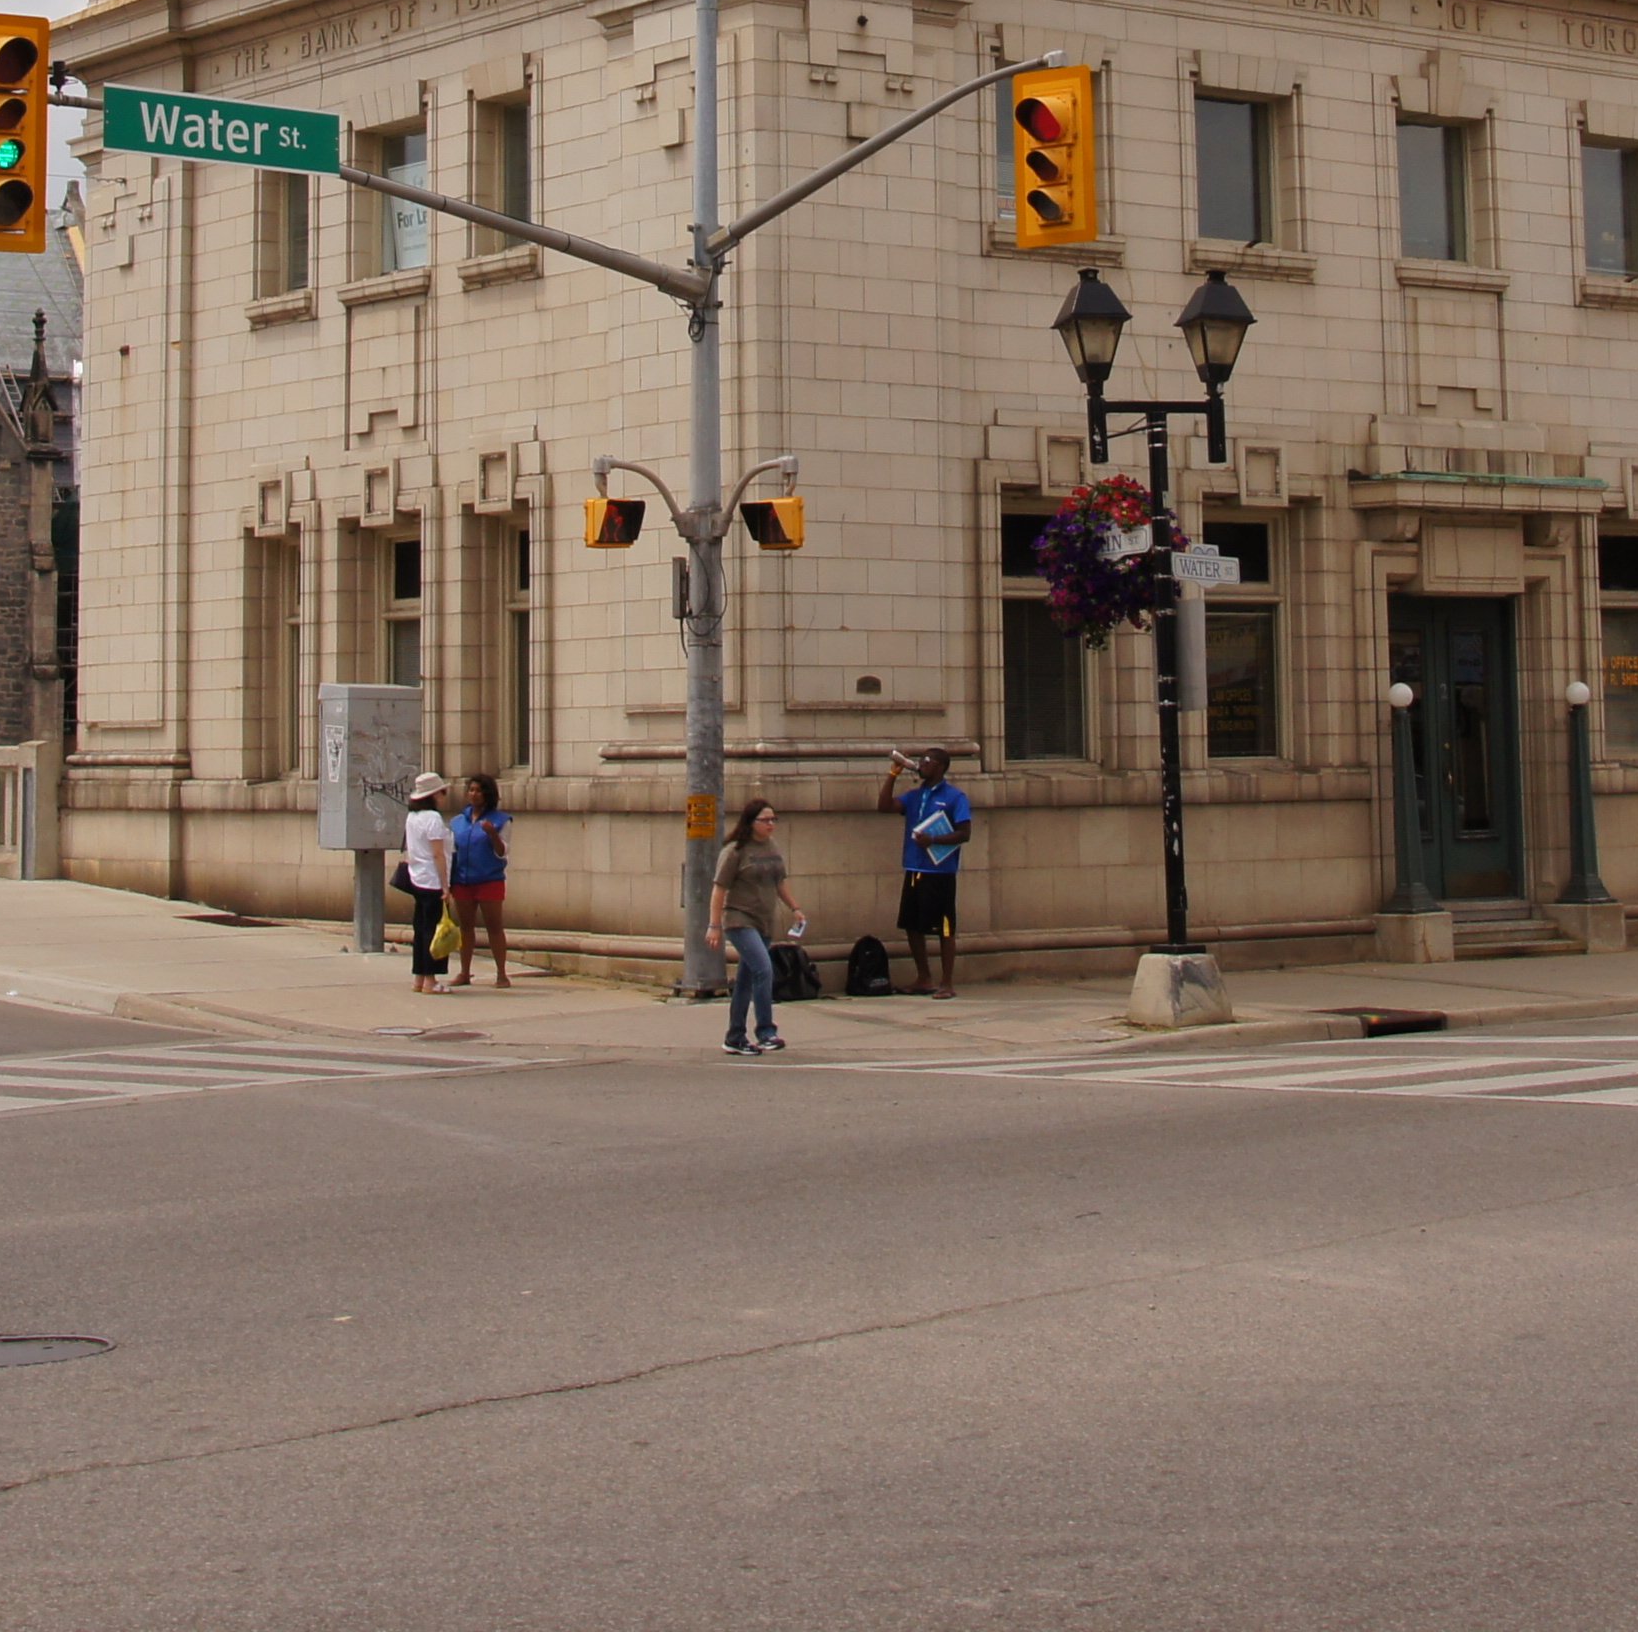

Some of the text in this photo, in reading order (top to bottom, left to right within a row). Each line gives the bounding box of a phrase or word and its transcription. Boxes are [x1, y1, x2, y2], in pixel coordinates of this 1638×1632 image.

[1451, 0, 1488, 32] OF
[231, 43, 270, 78] THE
[299, 16, 361, 60] BANK
[388, 0, 418, 34] OF
[139, 101, 307, 156] Water St.
[396, 211, 414, 229] For
[1179, 557, 1221, 578] WATER
